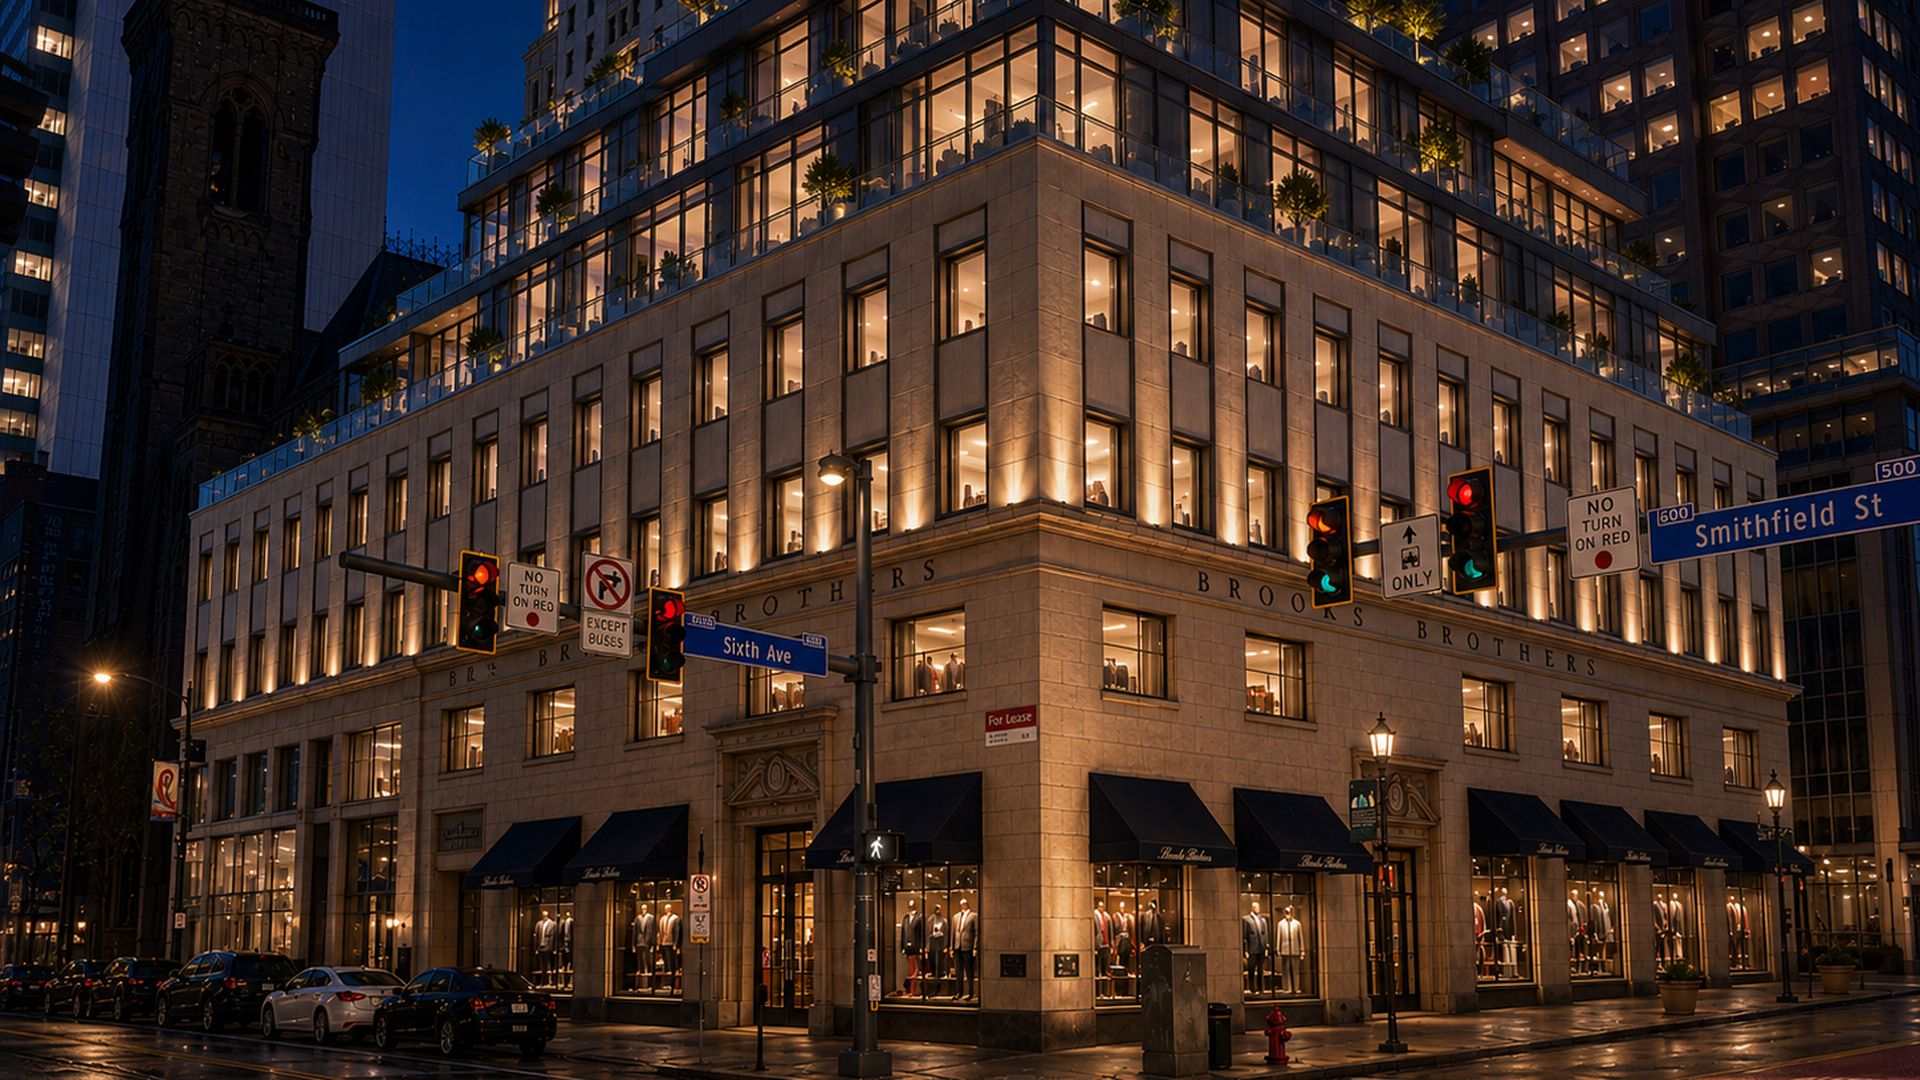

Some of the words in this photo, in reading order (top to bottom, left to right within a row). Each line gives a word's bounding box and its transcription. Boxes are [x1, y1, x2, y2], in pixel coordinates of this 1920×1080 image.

[1882, 460, 1916, 478] 500
[1587, 497, 1614, 515] NO
[1660, 507, 1688, 523] 600
[1582, 514, 1622, 532] TURN
[1695, 500, 1835, 548] Smithfield
[1855, 493, 1883, 520] St
[1575, 536, 1595, 551] ON
[1602, 530, 1631, 546] RED
[525, 570, 543, 583] NO
[1392, 570, 1432, 591] ONLY
[519, 584, 548, 597] TURN
[711, 559, 935, 623] ROTHRS
[513, 596, 528, 607] ON
[533, 599, 554, 612] RED
[587, 617, 627, 633] EXCEPT
[1197, 571, 1363, 627] BROOKS
[1417, 619, 1596, 676] BROTHERS
[723, 636, 759, 659] Sixth
[766, 644, 792, 664] Ave
[988, 715, 1003, 726] For
[1006, 713, 1032, 724] Lease
